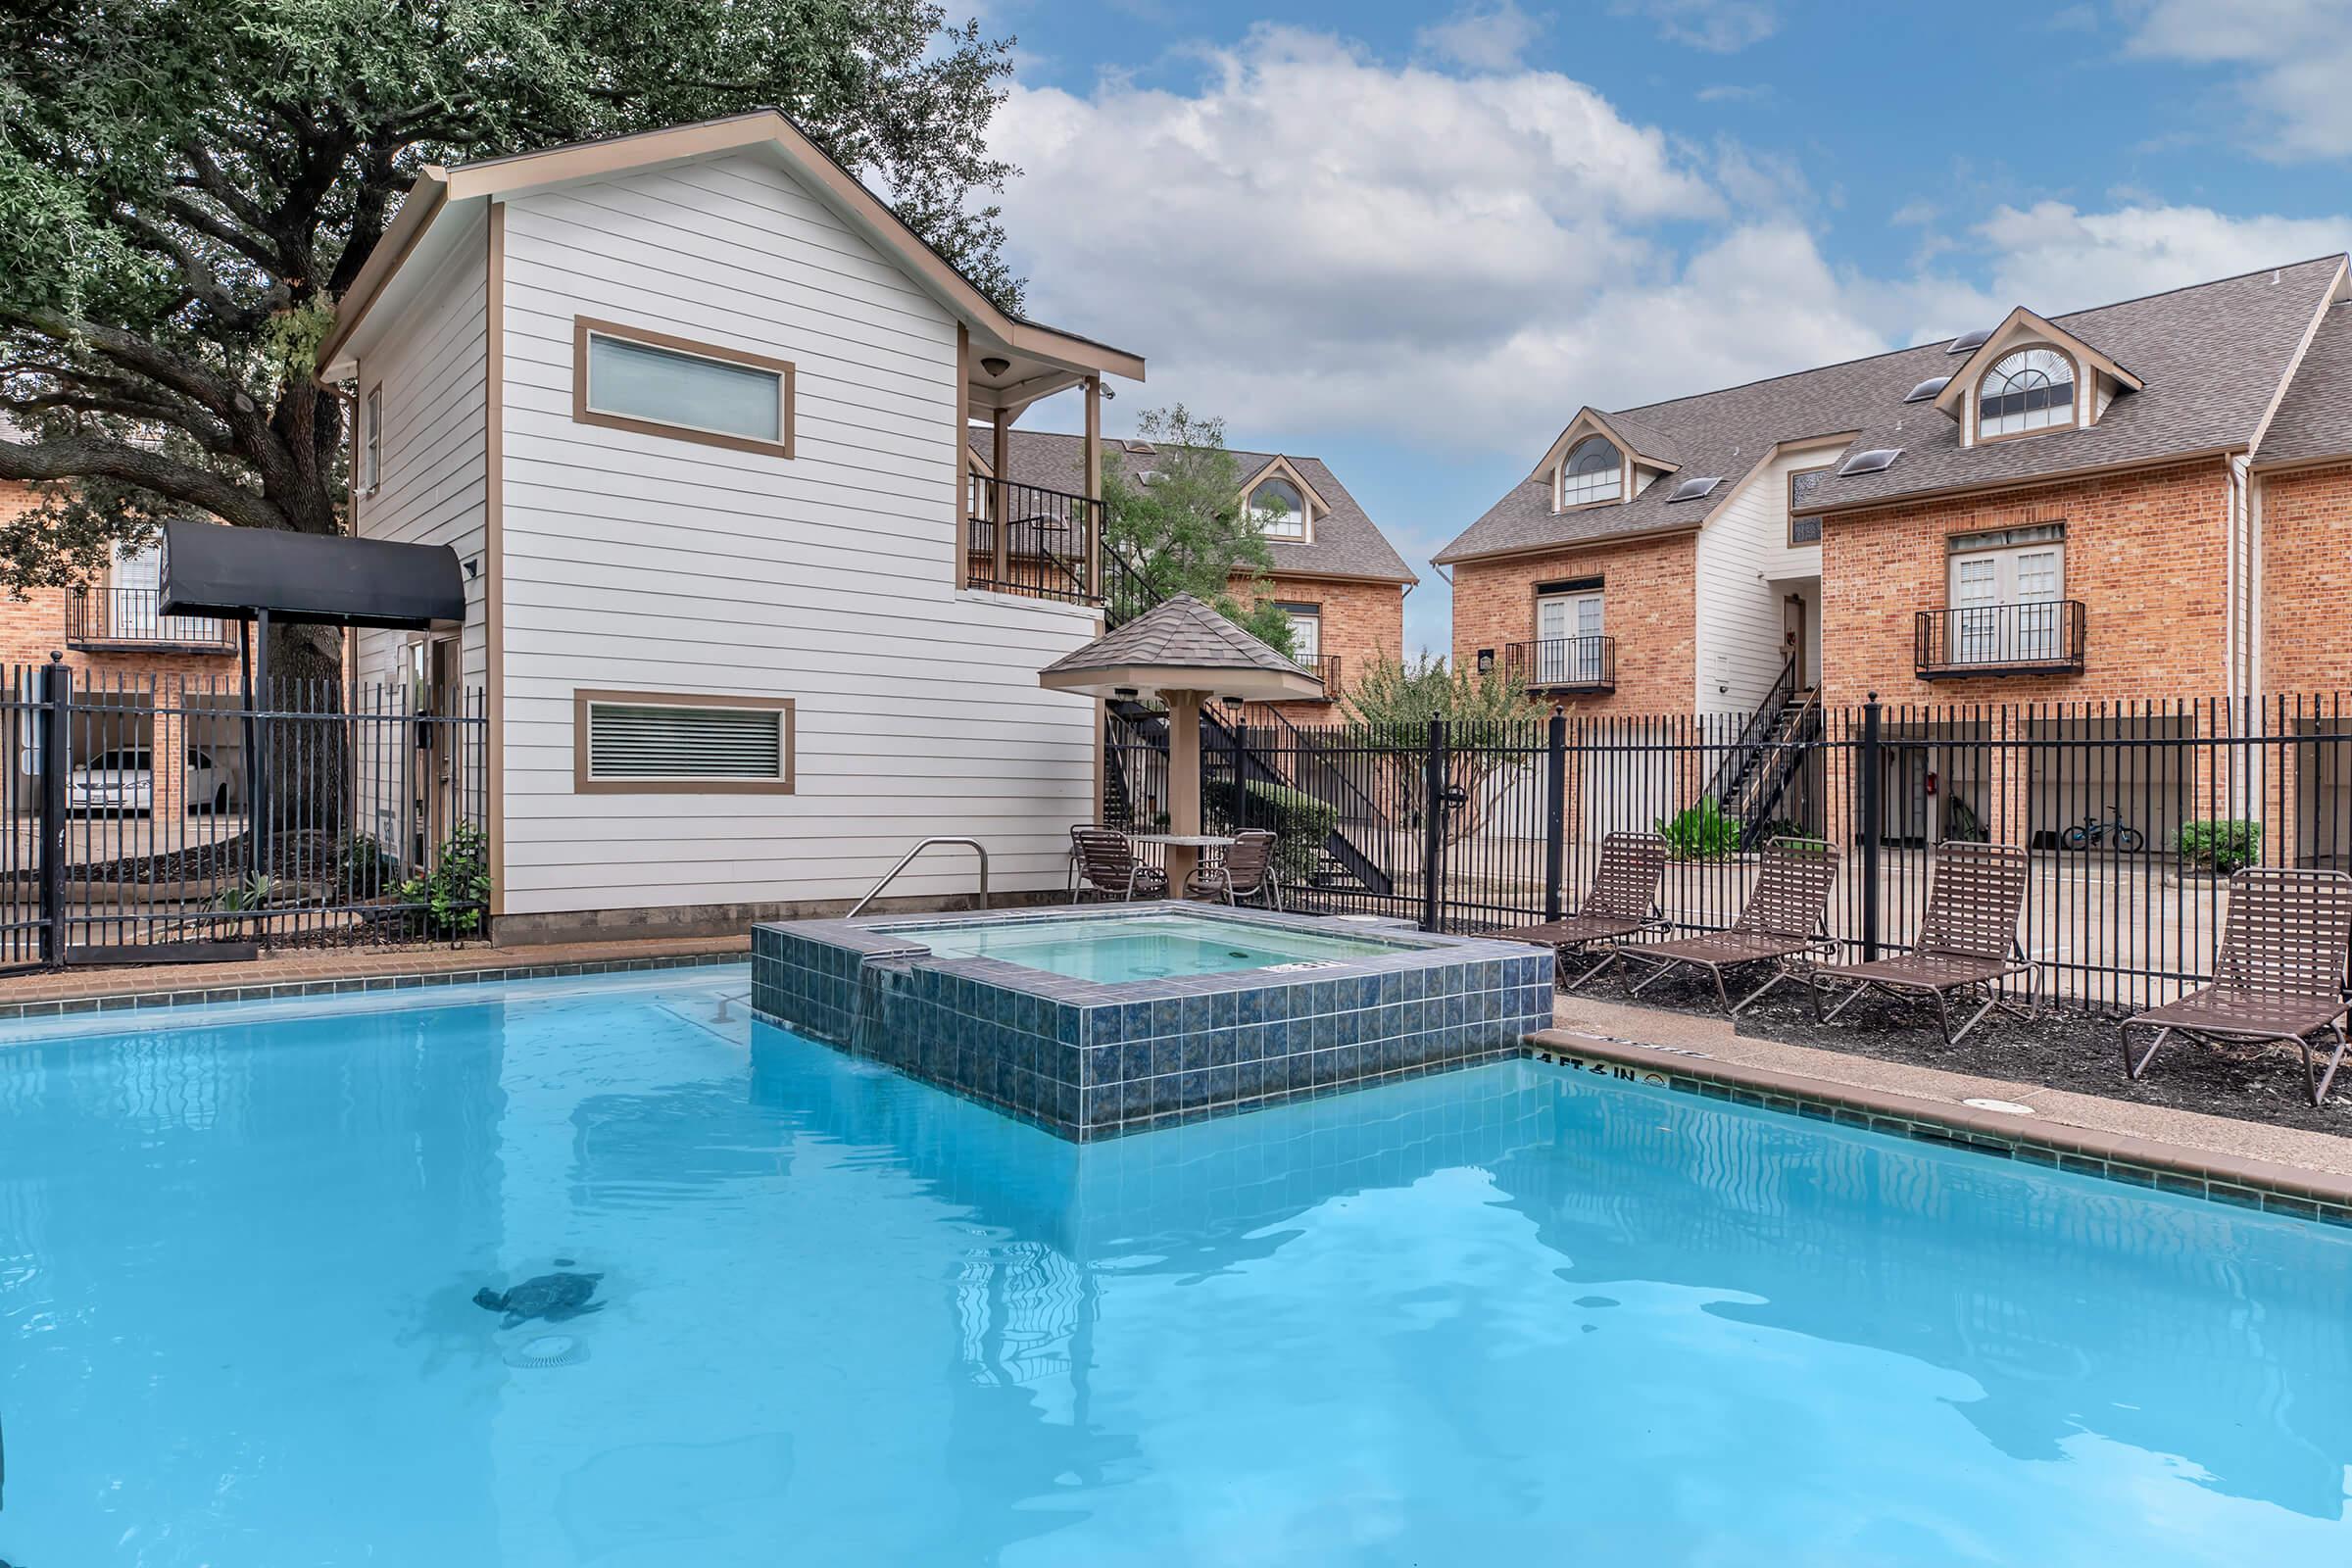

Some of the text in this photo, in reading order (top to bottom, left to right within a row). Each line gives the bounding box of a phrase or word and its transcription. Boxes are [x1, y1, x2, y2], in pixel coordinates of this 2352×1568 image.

[1537, 1054, 1552, 1063] 4
[1560, 1056, 1584, 1070] FT
[1613, 1066, 1636, 1082] IN
